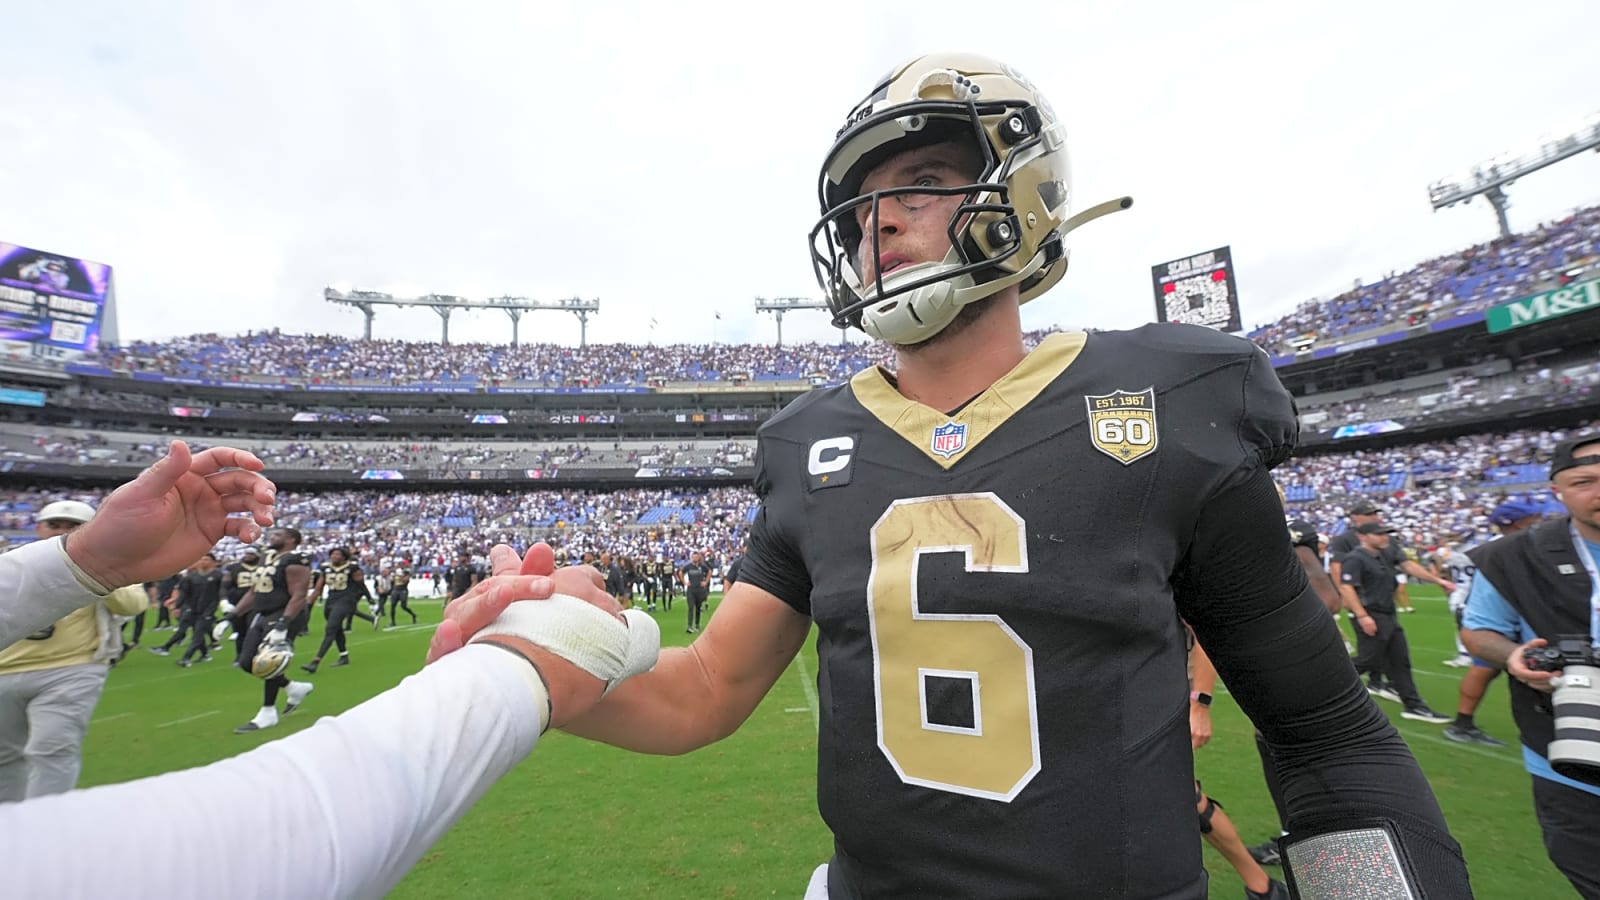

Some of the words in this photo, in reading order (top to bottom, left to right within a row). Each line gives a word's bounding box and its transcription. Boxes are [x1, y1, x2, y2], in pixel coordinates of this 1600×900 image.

[1096, 398, 1118, 409] EST.
[1119, 396, 1145, 406] 1967
[936, 436, 961, 451] NFL
[1096, 417, 1152, 446] 60
[808, 436, 854, 476] C
[867, 492, 1042, 803] 6
